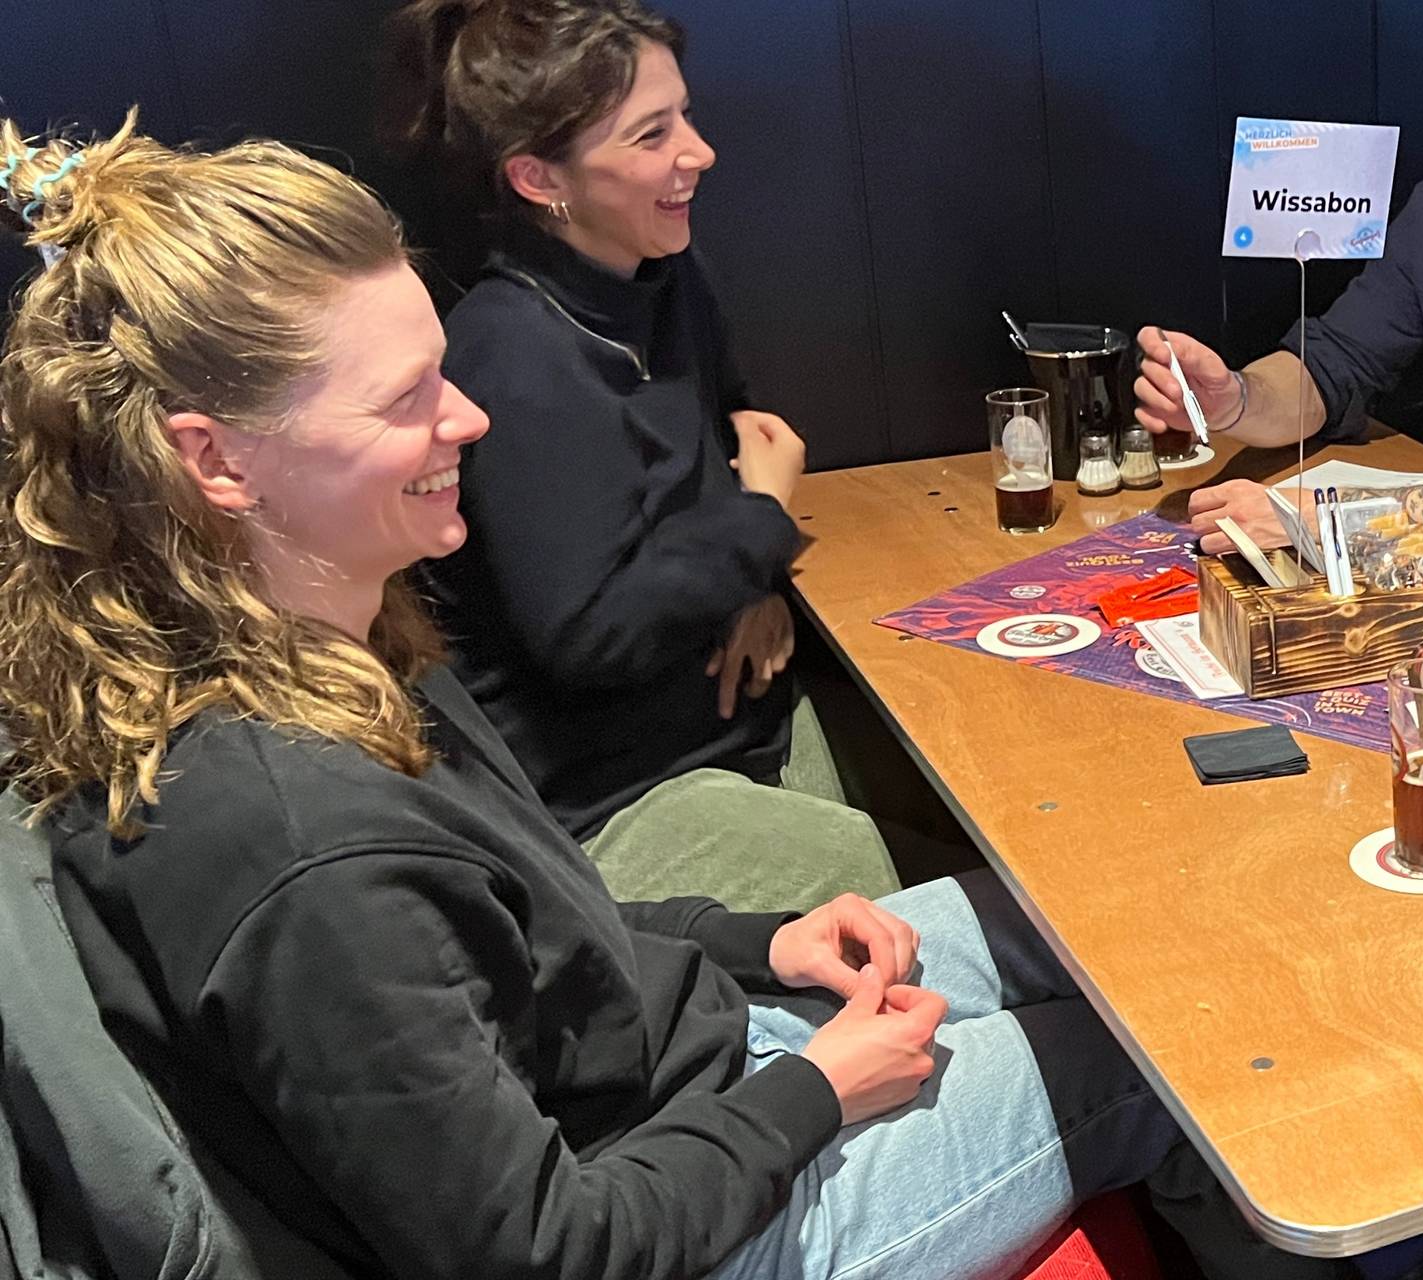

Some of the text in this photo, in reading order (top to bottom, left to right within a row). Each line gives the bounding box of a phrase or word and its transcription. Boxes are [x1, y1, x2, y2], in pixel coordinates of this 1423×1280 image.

[1245, 130, 1293, 140] HERZLICH
[1252, 138, 1318, 150] WILLKOMMEN
[1252, 189, 1372, 214] Wissabon
[1321, 690, 1364, 699] BEST
[1330, 695, 1373, 706] QUIZ
[1314, 706, 1365, 716] TOWN
